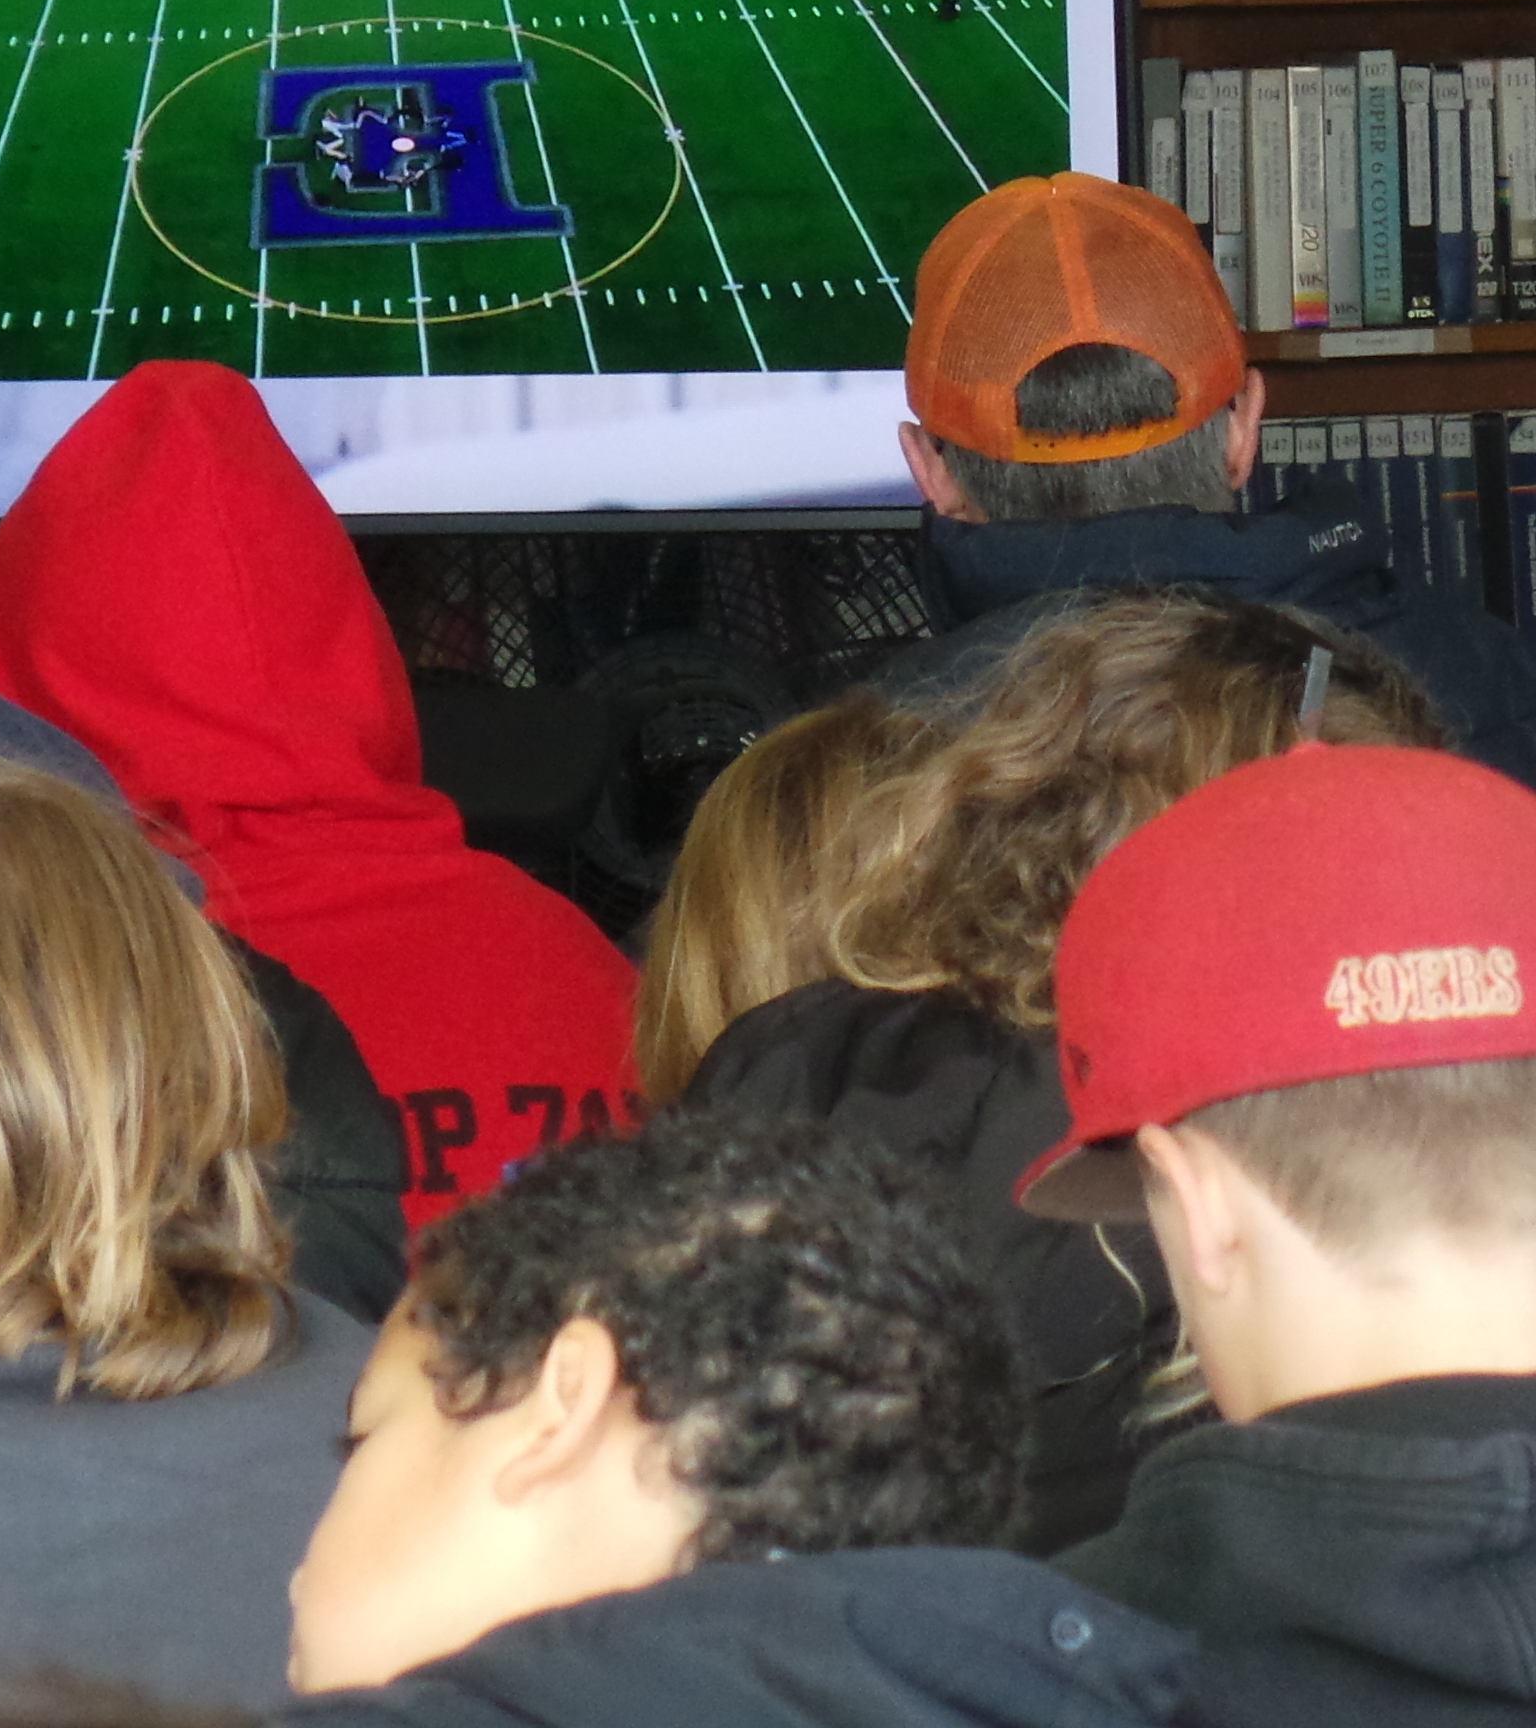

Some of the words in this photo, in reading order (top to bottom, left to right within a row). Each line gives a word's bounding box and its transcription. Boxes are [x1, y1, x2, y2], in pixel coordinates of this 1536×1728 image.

[1364, 63, 1388, 77] 107
[1216, 85, 1239, 98] 103
[1256, 88, 1280, 101] 104
[1294, 82, 1318, 96] 105
[1327, 83, 1352, 97] 106
[1436, 87, 1458, 99] 109
[1370, 179, 1392, 282] COYOTE
[1298, 273, 1324, 287] VHS
[1334, 301, 1359, 315] VHS
[1333, 433, 1361, 449] 149
[1368, 432, 1394, 447] 150
[1403, 429, 1428, 445] 151
[1442, 432, 1469, 448] 152
[1264, 436, 1289, 453] 147
[1297, 438, 1323, 454] 148
[1323, 944, 1525, 1029] 49ERS
